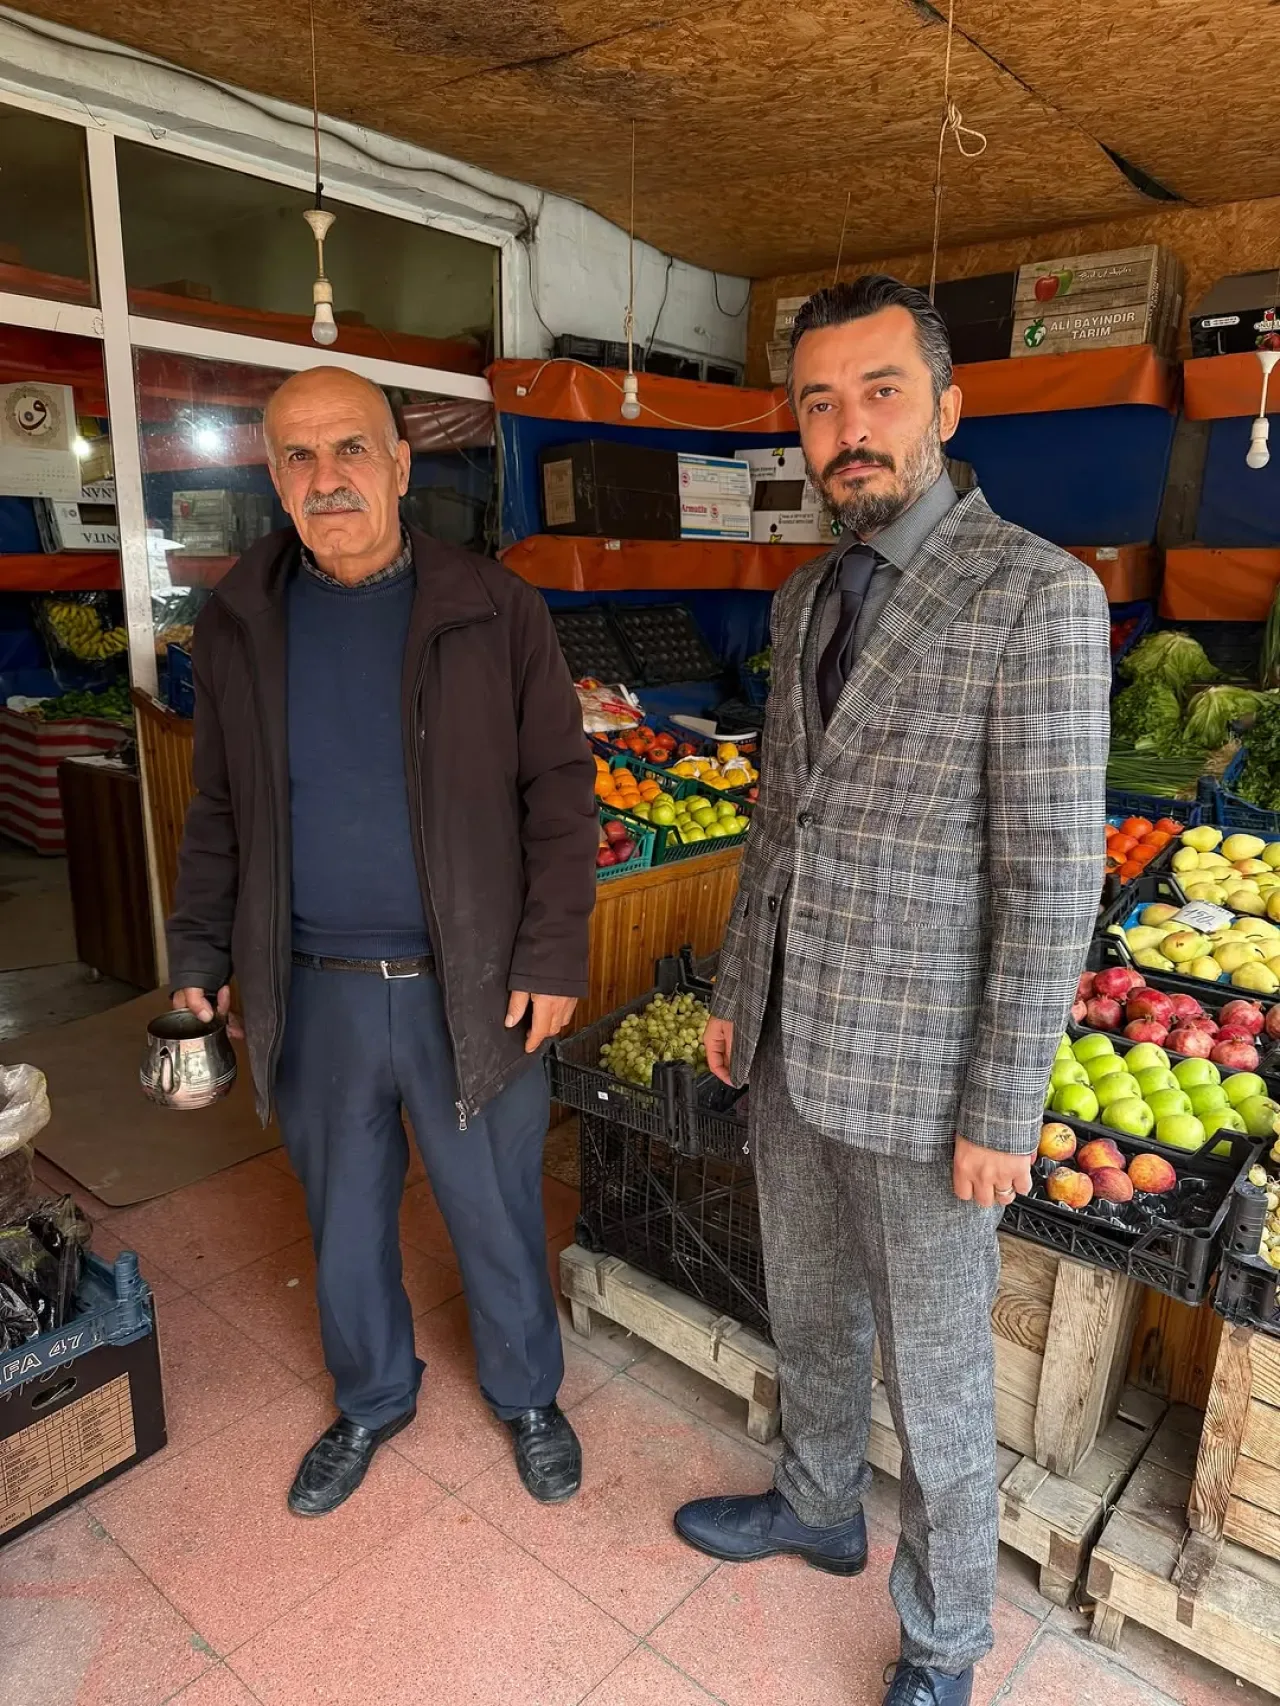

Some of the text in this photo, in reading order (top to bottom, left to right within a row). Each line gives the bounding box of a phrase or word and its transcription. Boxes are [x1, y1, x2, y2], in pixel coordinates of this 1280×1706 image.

[1074, 312, 1135, 328] BAYINDIR
[1071, 327, 1111, 340] TARIM
[49, 1332, 84, 1357] 47
